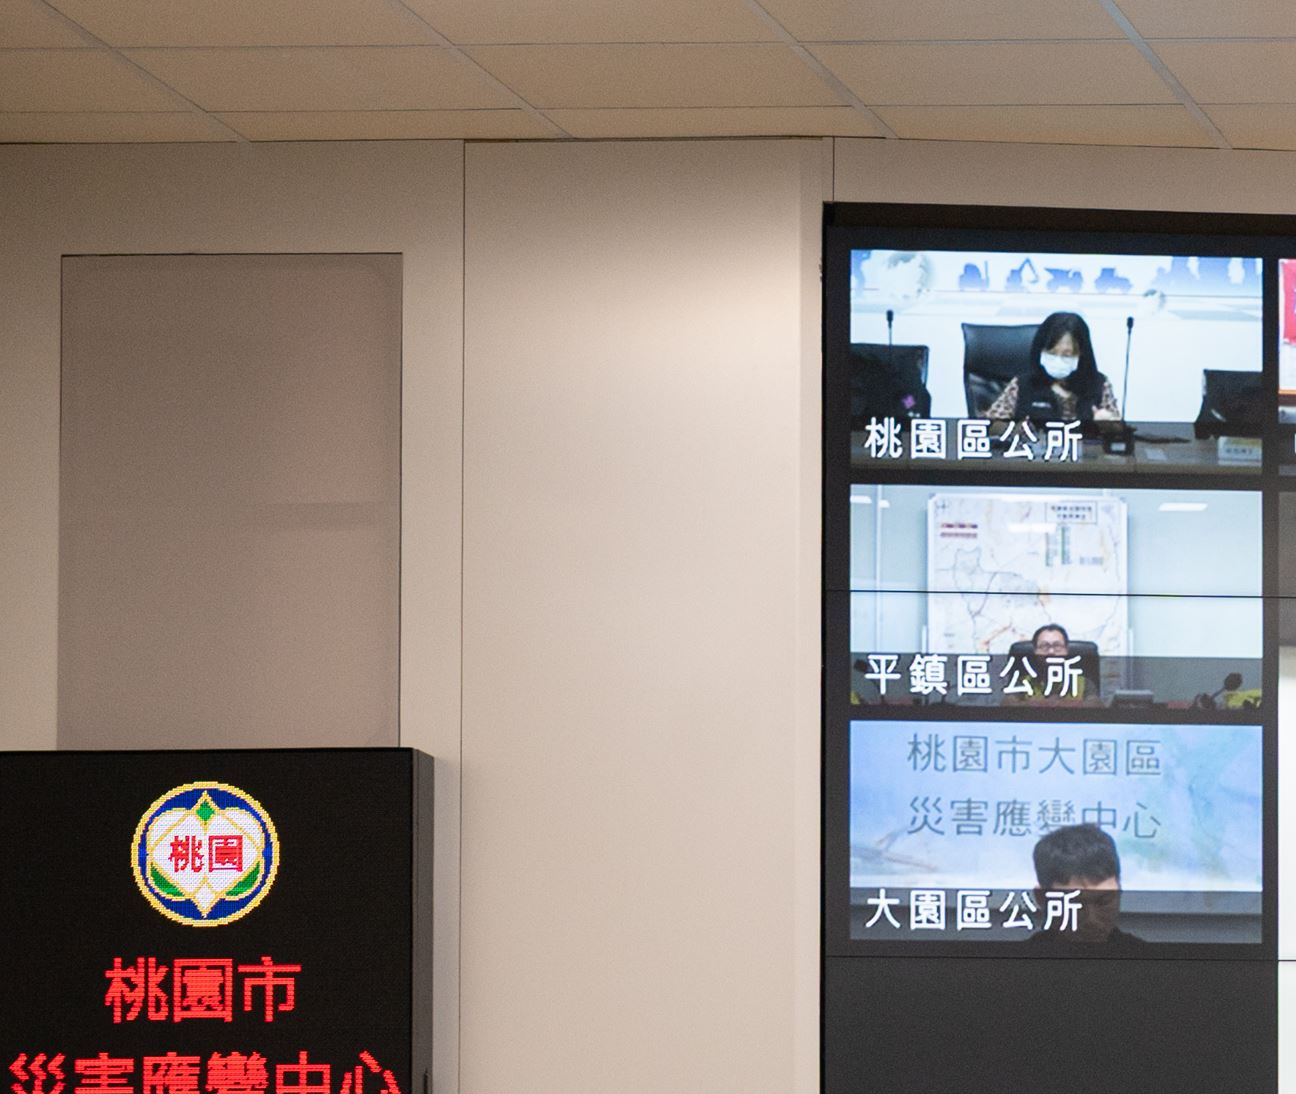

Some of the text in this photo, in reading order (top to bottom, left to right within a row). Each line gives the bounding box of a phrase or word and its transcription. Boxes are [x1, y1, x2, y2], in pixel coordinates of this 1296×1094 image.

[864, 417, 1083, 462] 桃園區公所
[864, 653, 1084, 698] 平鎮區公所
[907, 732, 1162, 777] 桃園市大園區
[167, 835, 243, 873] 桃園
[865, 889, 1083, 932] 大園區公所
[105, 956, 302, 1023] 桃園市
